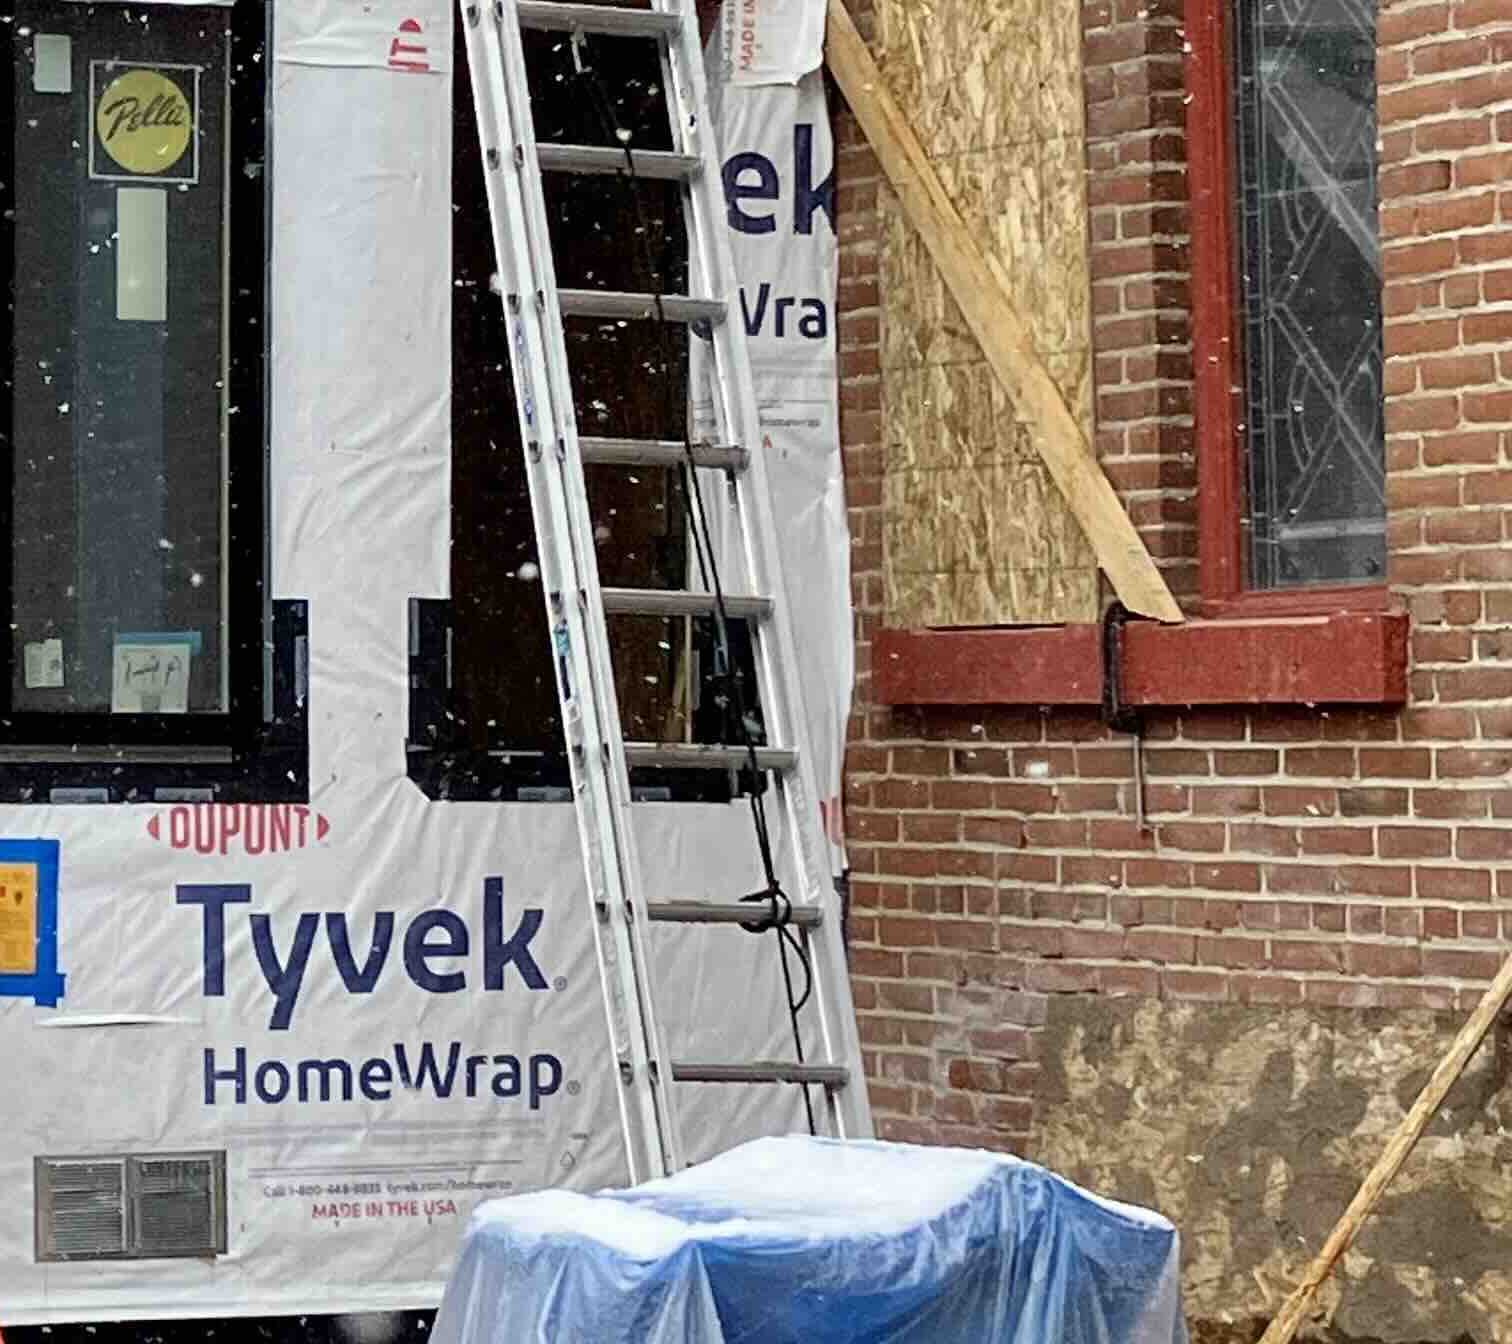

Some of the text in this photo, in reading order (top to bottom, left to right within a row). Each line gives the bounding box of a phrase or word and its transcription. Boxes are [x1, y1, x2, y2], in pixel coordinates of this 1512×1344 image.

[170, 805, 311, 855] DUPONT
[176, 876, 548, 1030] Tyvek
[203, 1042, 563, 1109] HomeWrap
[311, 1200, 457, 1219] MADE IN THE USA
